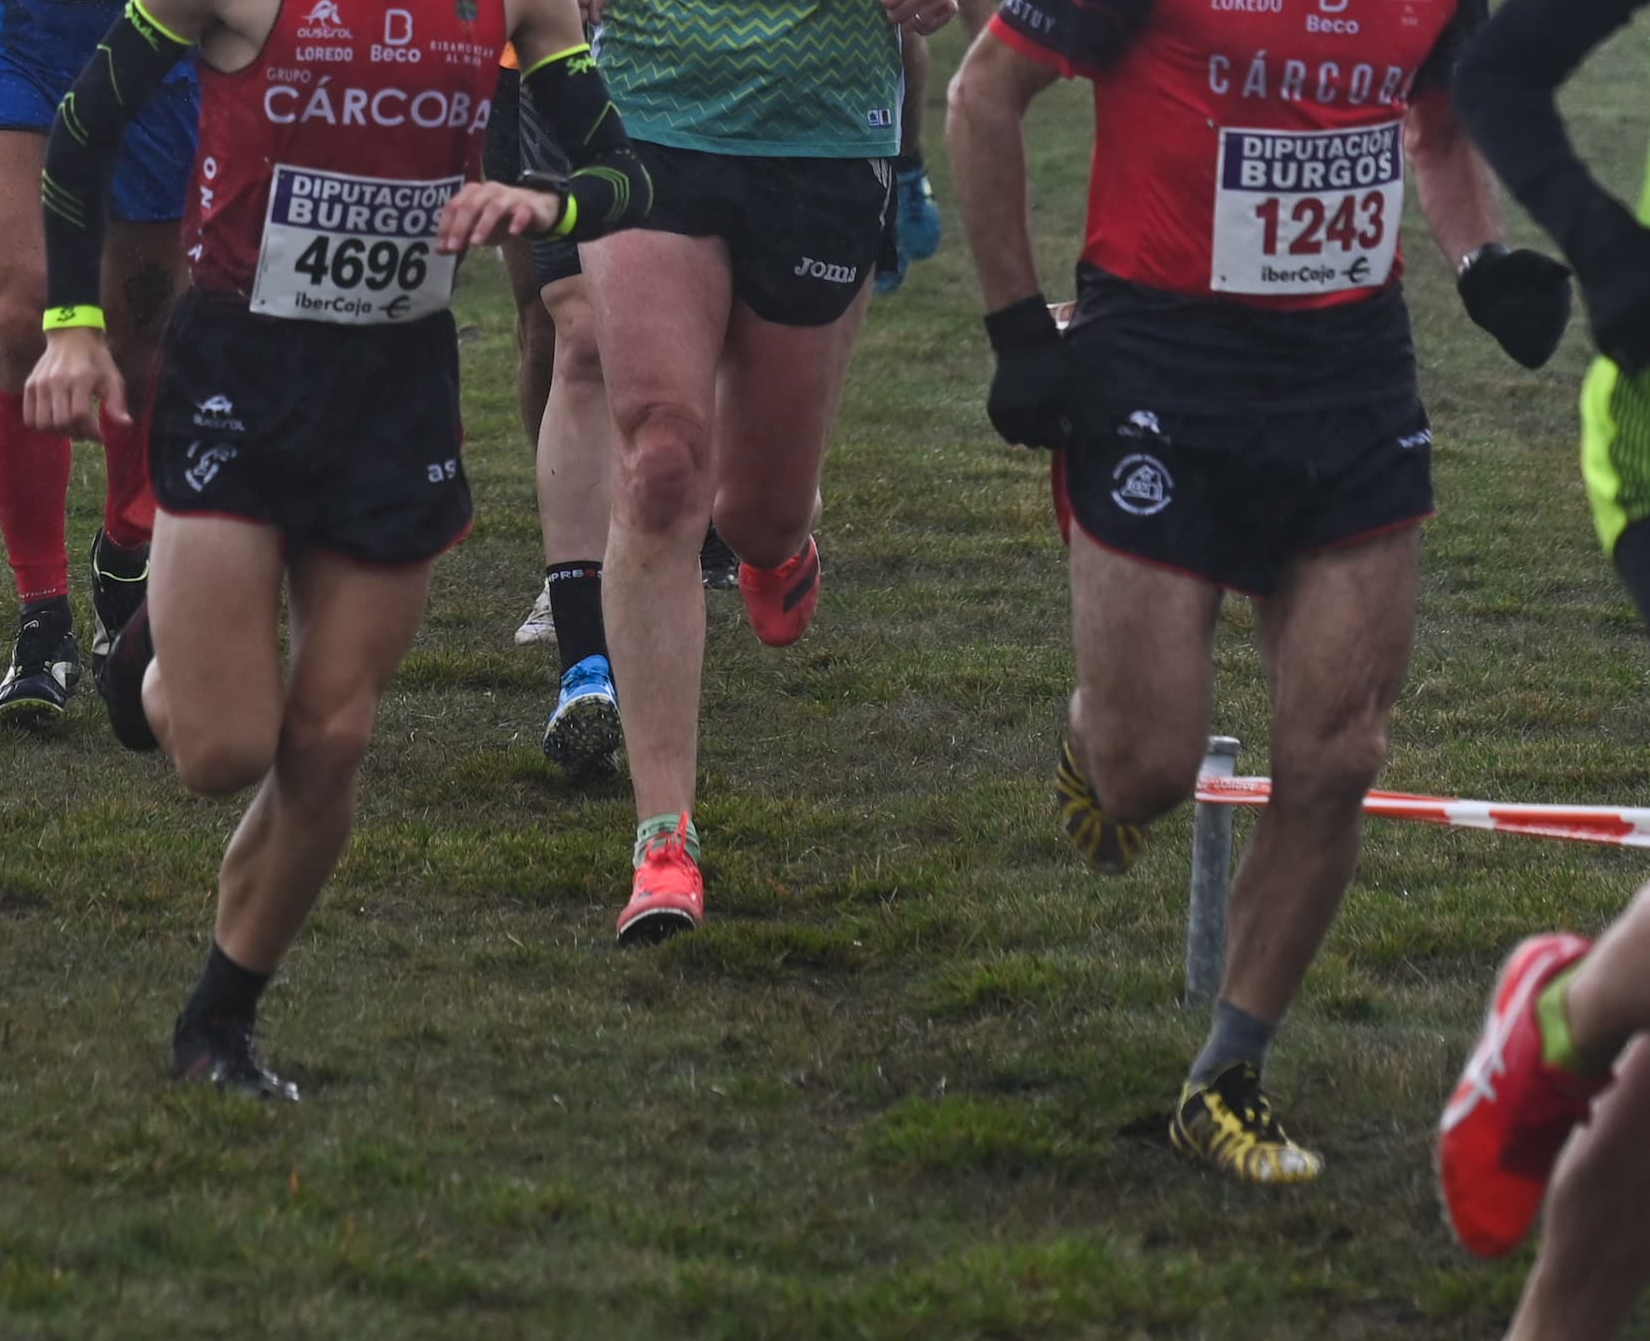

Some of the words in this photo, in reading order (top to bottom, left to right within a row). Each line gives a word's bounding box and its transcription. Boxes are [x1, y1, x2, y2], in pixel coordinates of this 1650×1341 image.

[1306, 14, 1360, 35] Beco
[295, 46, 354, 62] LOREDO
[370, 43, 422, 64] Beco
[266, 65, 312, 84] GRUPO
[263, 76, 492, 136] CÁRCOBA
[1242, 129, 1395, 160] DIPUTACIÓN
[1240, 153, 1392, 189] BURGOS
[291, 175, 452, 209] DIPUTACIÓN
[1255, 189, 1385, 256] 1243
[293, 235, 430, 292] 4696
[1261, 264, 1335, 284] iberCaja
[295, 292, 373, 316] iberCaja
